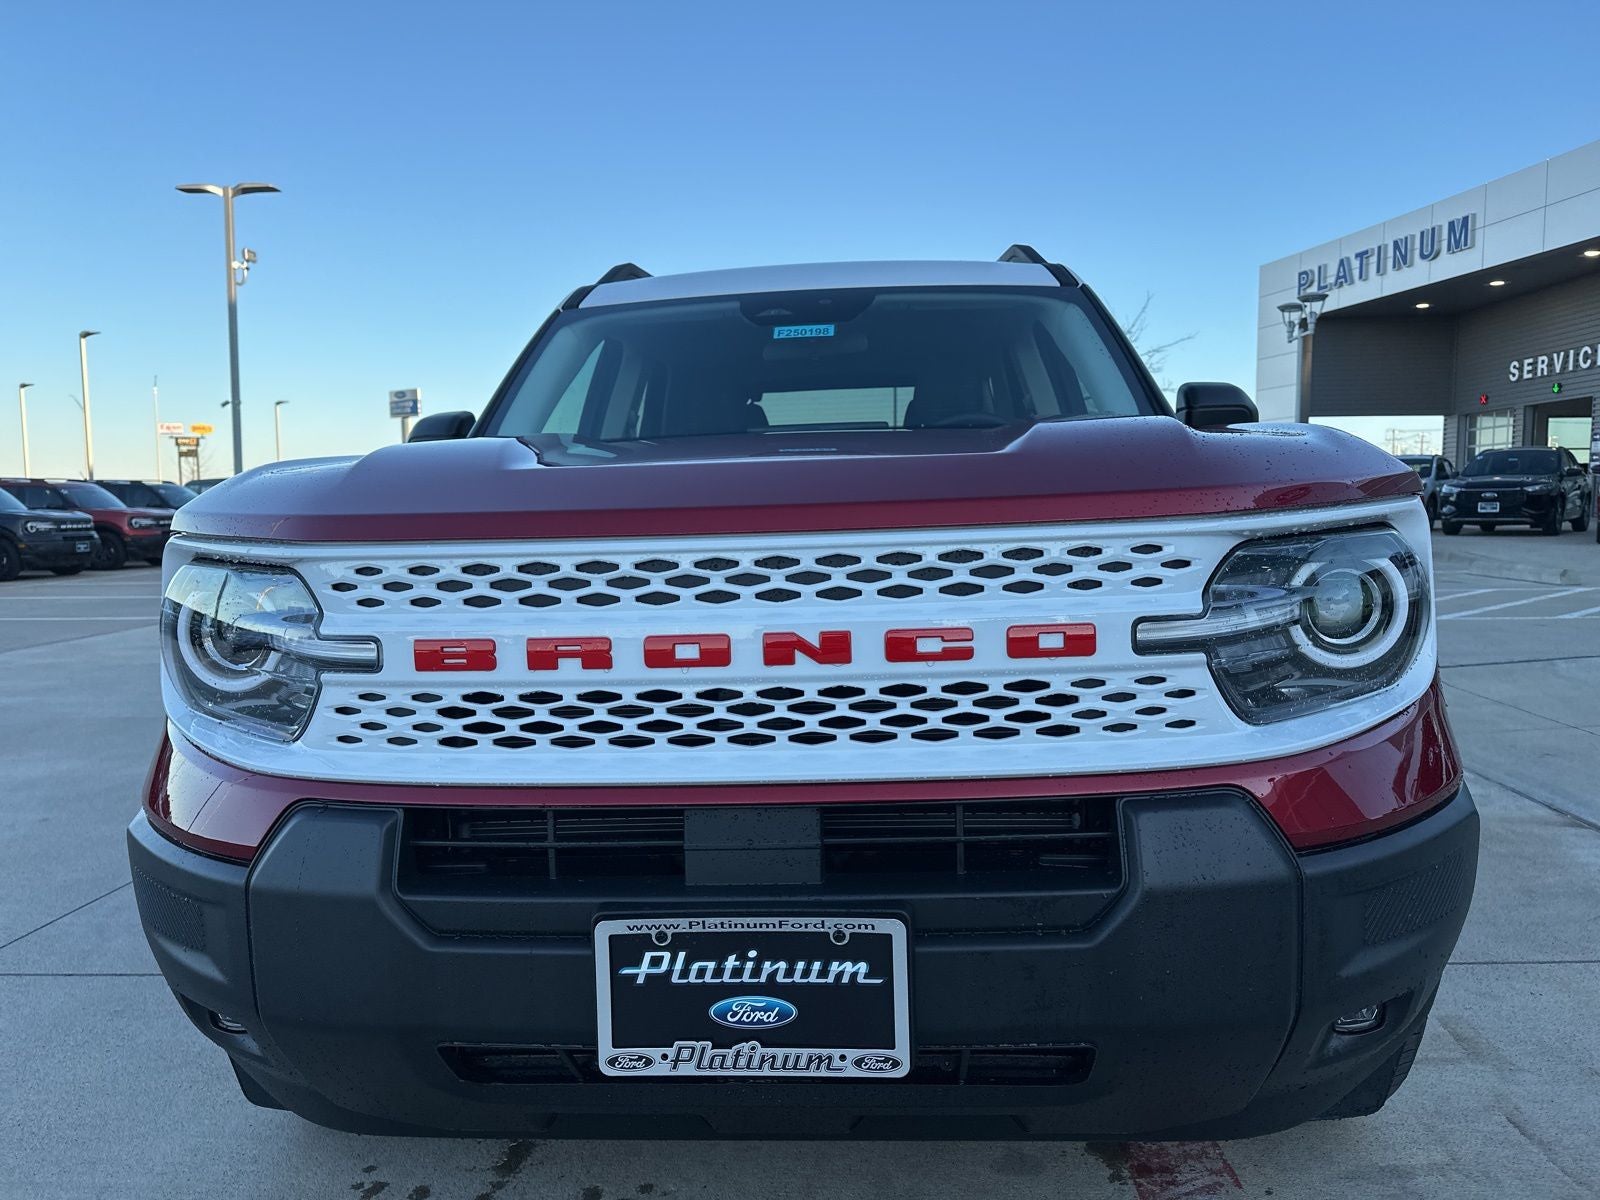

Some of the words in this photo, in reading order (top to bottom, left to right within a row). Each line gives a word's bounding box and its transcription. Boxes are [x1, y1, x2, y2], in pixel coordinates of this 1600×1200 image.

[1297, 213, 1477, 297] PLATINUM
[776, 327, 831, 338] F250198
[413, 622, 1098, 673] BRONCO
[626, 919, 876, 932] www.PlatinumFord.com
[618, 950, 886, 985] Platinum
[726, 1001, 779, 1023] Ford
[614, 1055, 646, 1069] Ford
[661, 1041, 847, 1073] Platinum
[861, 1056, 893, 1070] Ford
